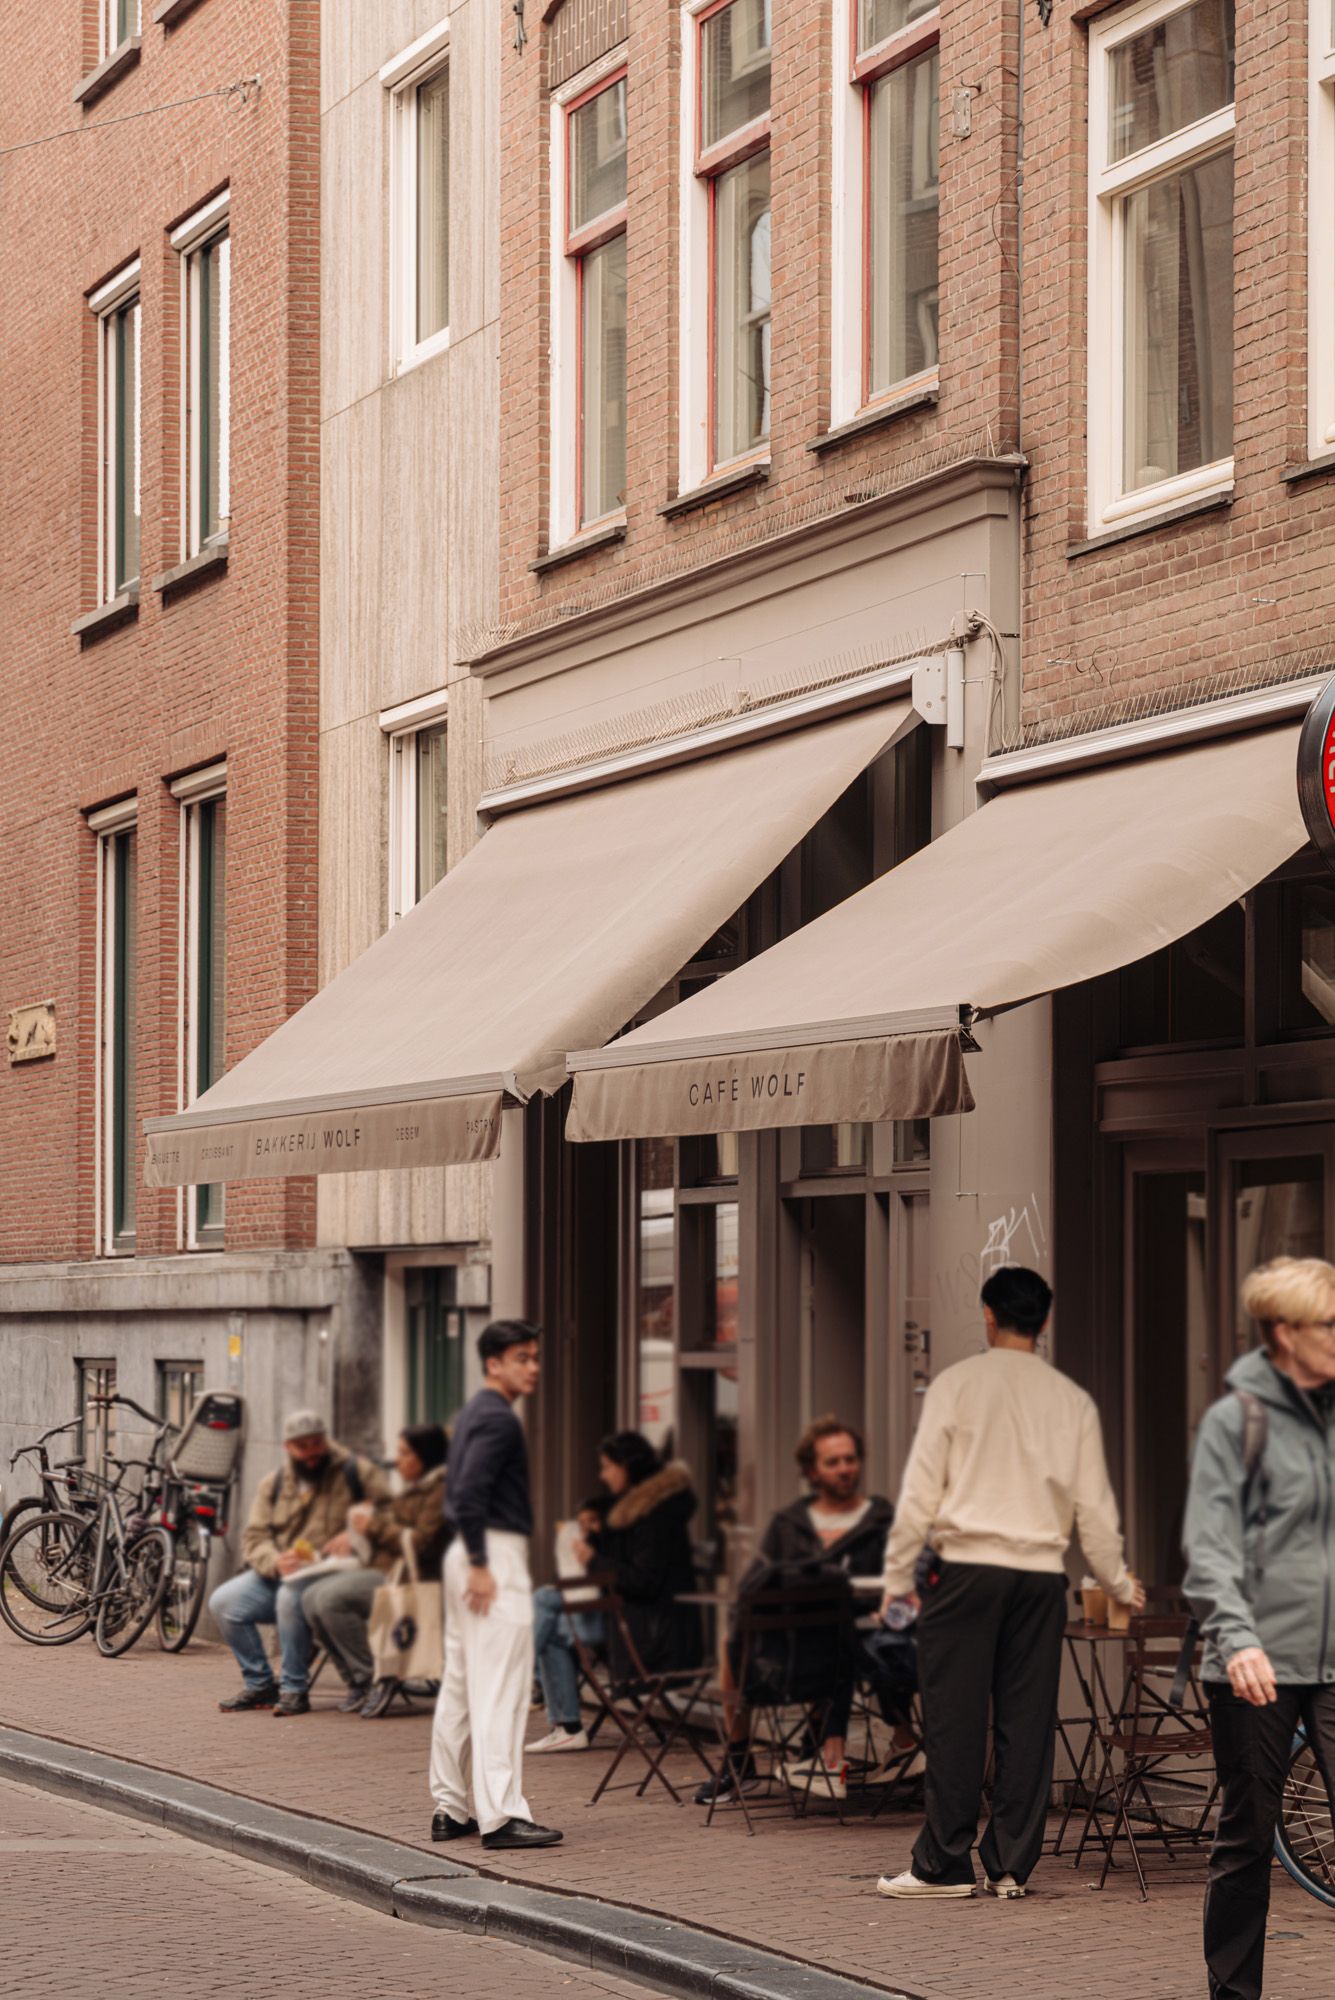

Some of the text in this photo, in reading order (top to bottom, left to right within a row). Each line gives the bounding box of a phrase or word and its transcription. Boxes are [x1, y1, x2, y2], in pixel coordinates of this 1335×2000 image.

[689, 1068, 806, 1106] CAFÉ WOLF
[395, 1127, 420, 1140] DESEM
[466, 1118, 495, 1134] PASTRY
[255, 1128, 361, 1156] BAKKERIJ WOLF
